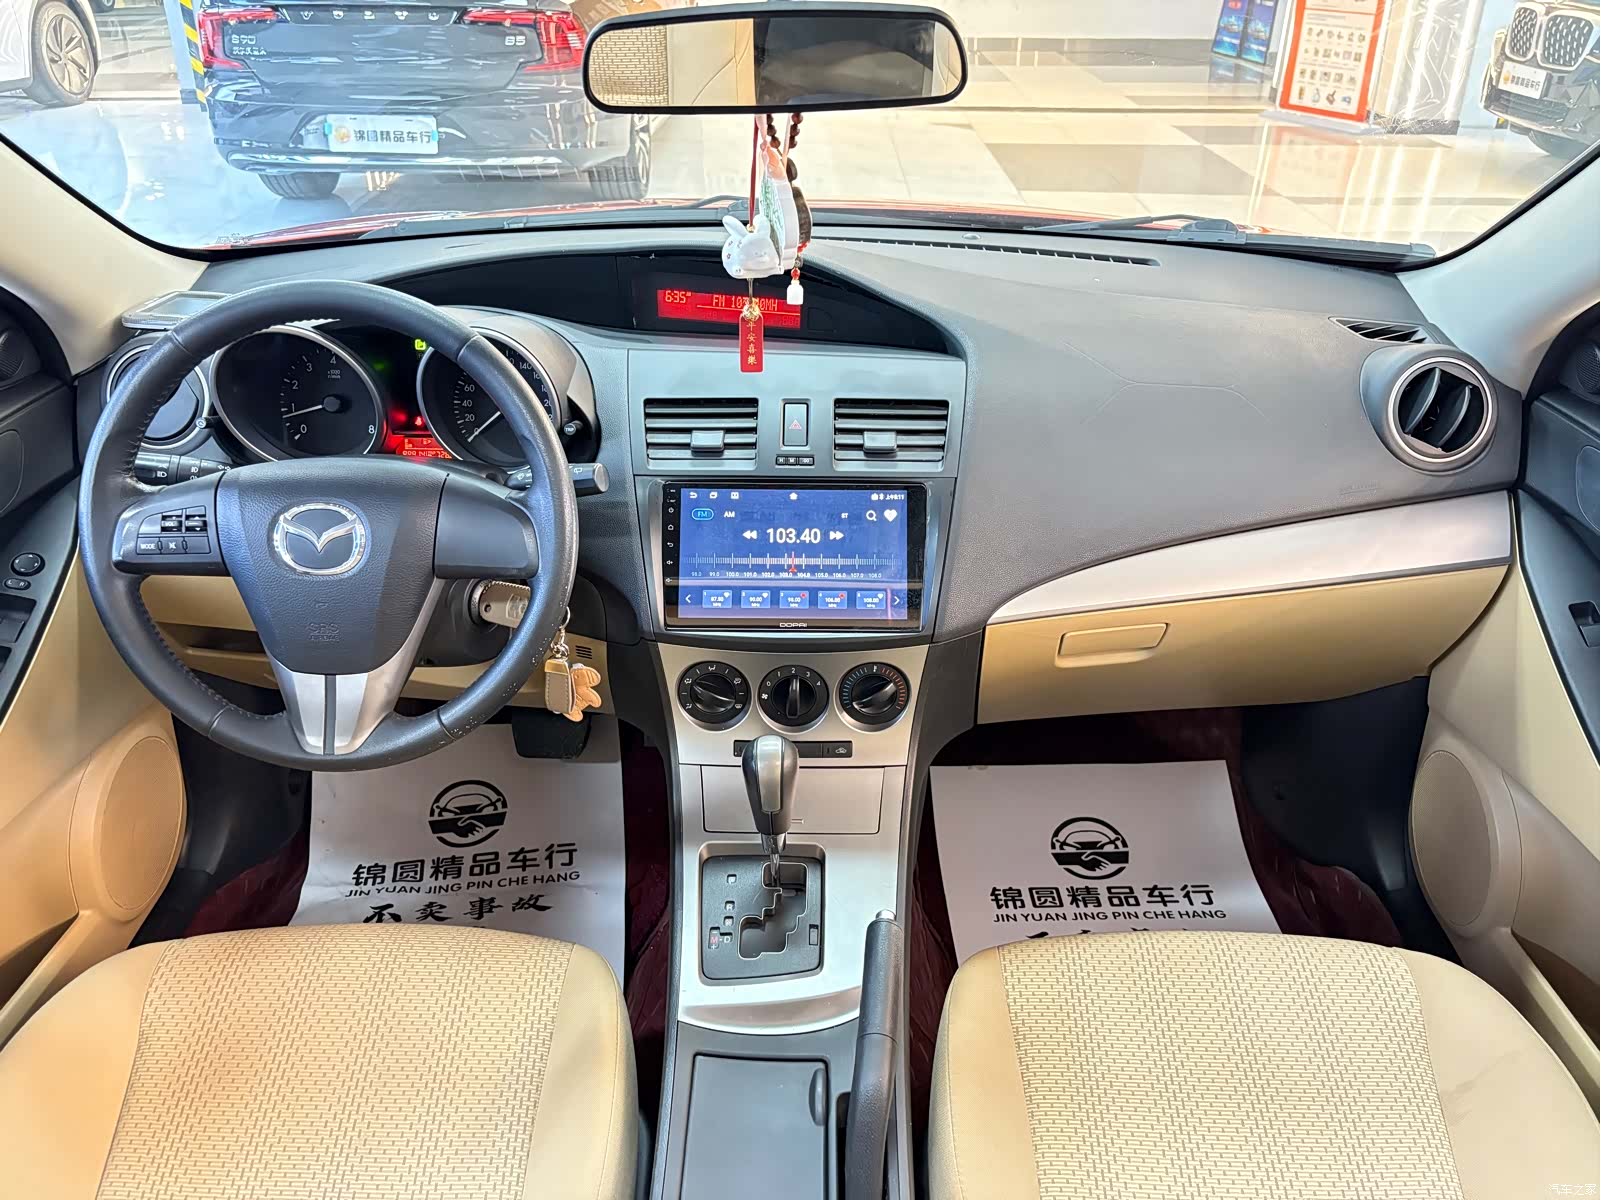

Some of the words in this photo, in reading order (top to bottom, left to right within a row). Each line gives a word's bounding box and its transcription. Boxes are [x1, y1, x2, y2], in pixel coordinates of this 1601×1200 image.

[231, 34, 256, 44] S90
[329, 355, 337, 365] 4
[306, 362, 313, 372] 3
[291, 380, 299, 390] 2
[463, 384, 476, 392] 60
[462, 399, 473, 407] 40
[464, 413, 475, 422] 20
[300, 424, 307, 434] 0
[368, 425, 375, 434] 8
[697, 510, 708, 518] FM
[766, 527, 821, 544] 103.40
[352, 842, 578, 886] 锦圆精品车行
[345, 889, 371, 898] JIN
[375, 885, 421, 894] YUAN
[425, 883, 462, 895] JING
[466, 880, 493, 890] PIN
[497, 876, 529, 887] CHE
[533, 871, 580, 884] HANG
[990, 884, 1214, 910] 锦圆精品车行
[362, 894, 553, 924] 不卖事故
[993, 913, 1018, 923] JIN
[1020, 912, 1068, 922] YUAN
[1072, 911, 1108, 921] JING
[1112, 911, 1140, 920] PIN
[1142, 910, 1176, 919] CHE
[1177, 909, 1227, 919] HANG
[710, 936, 719, 944] M
